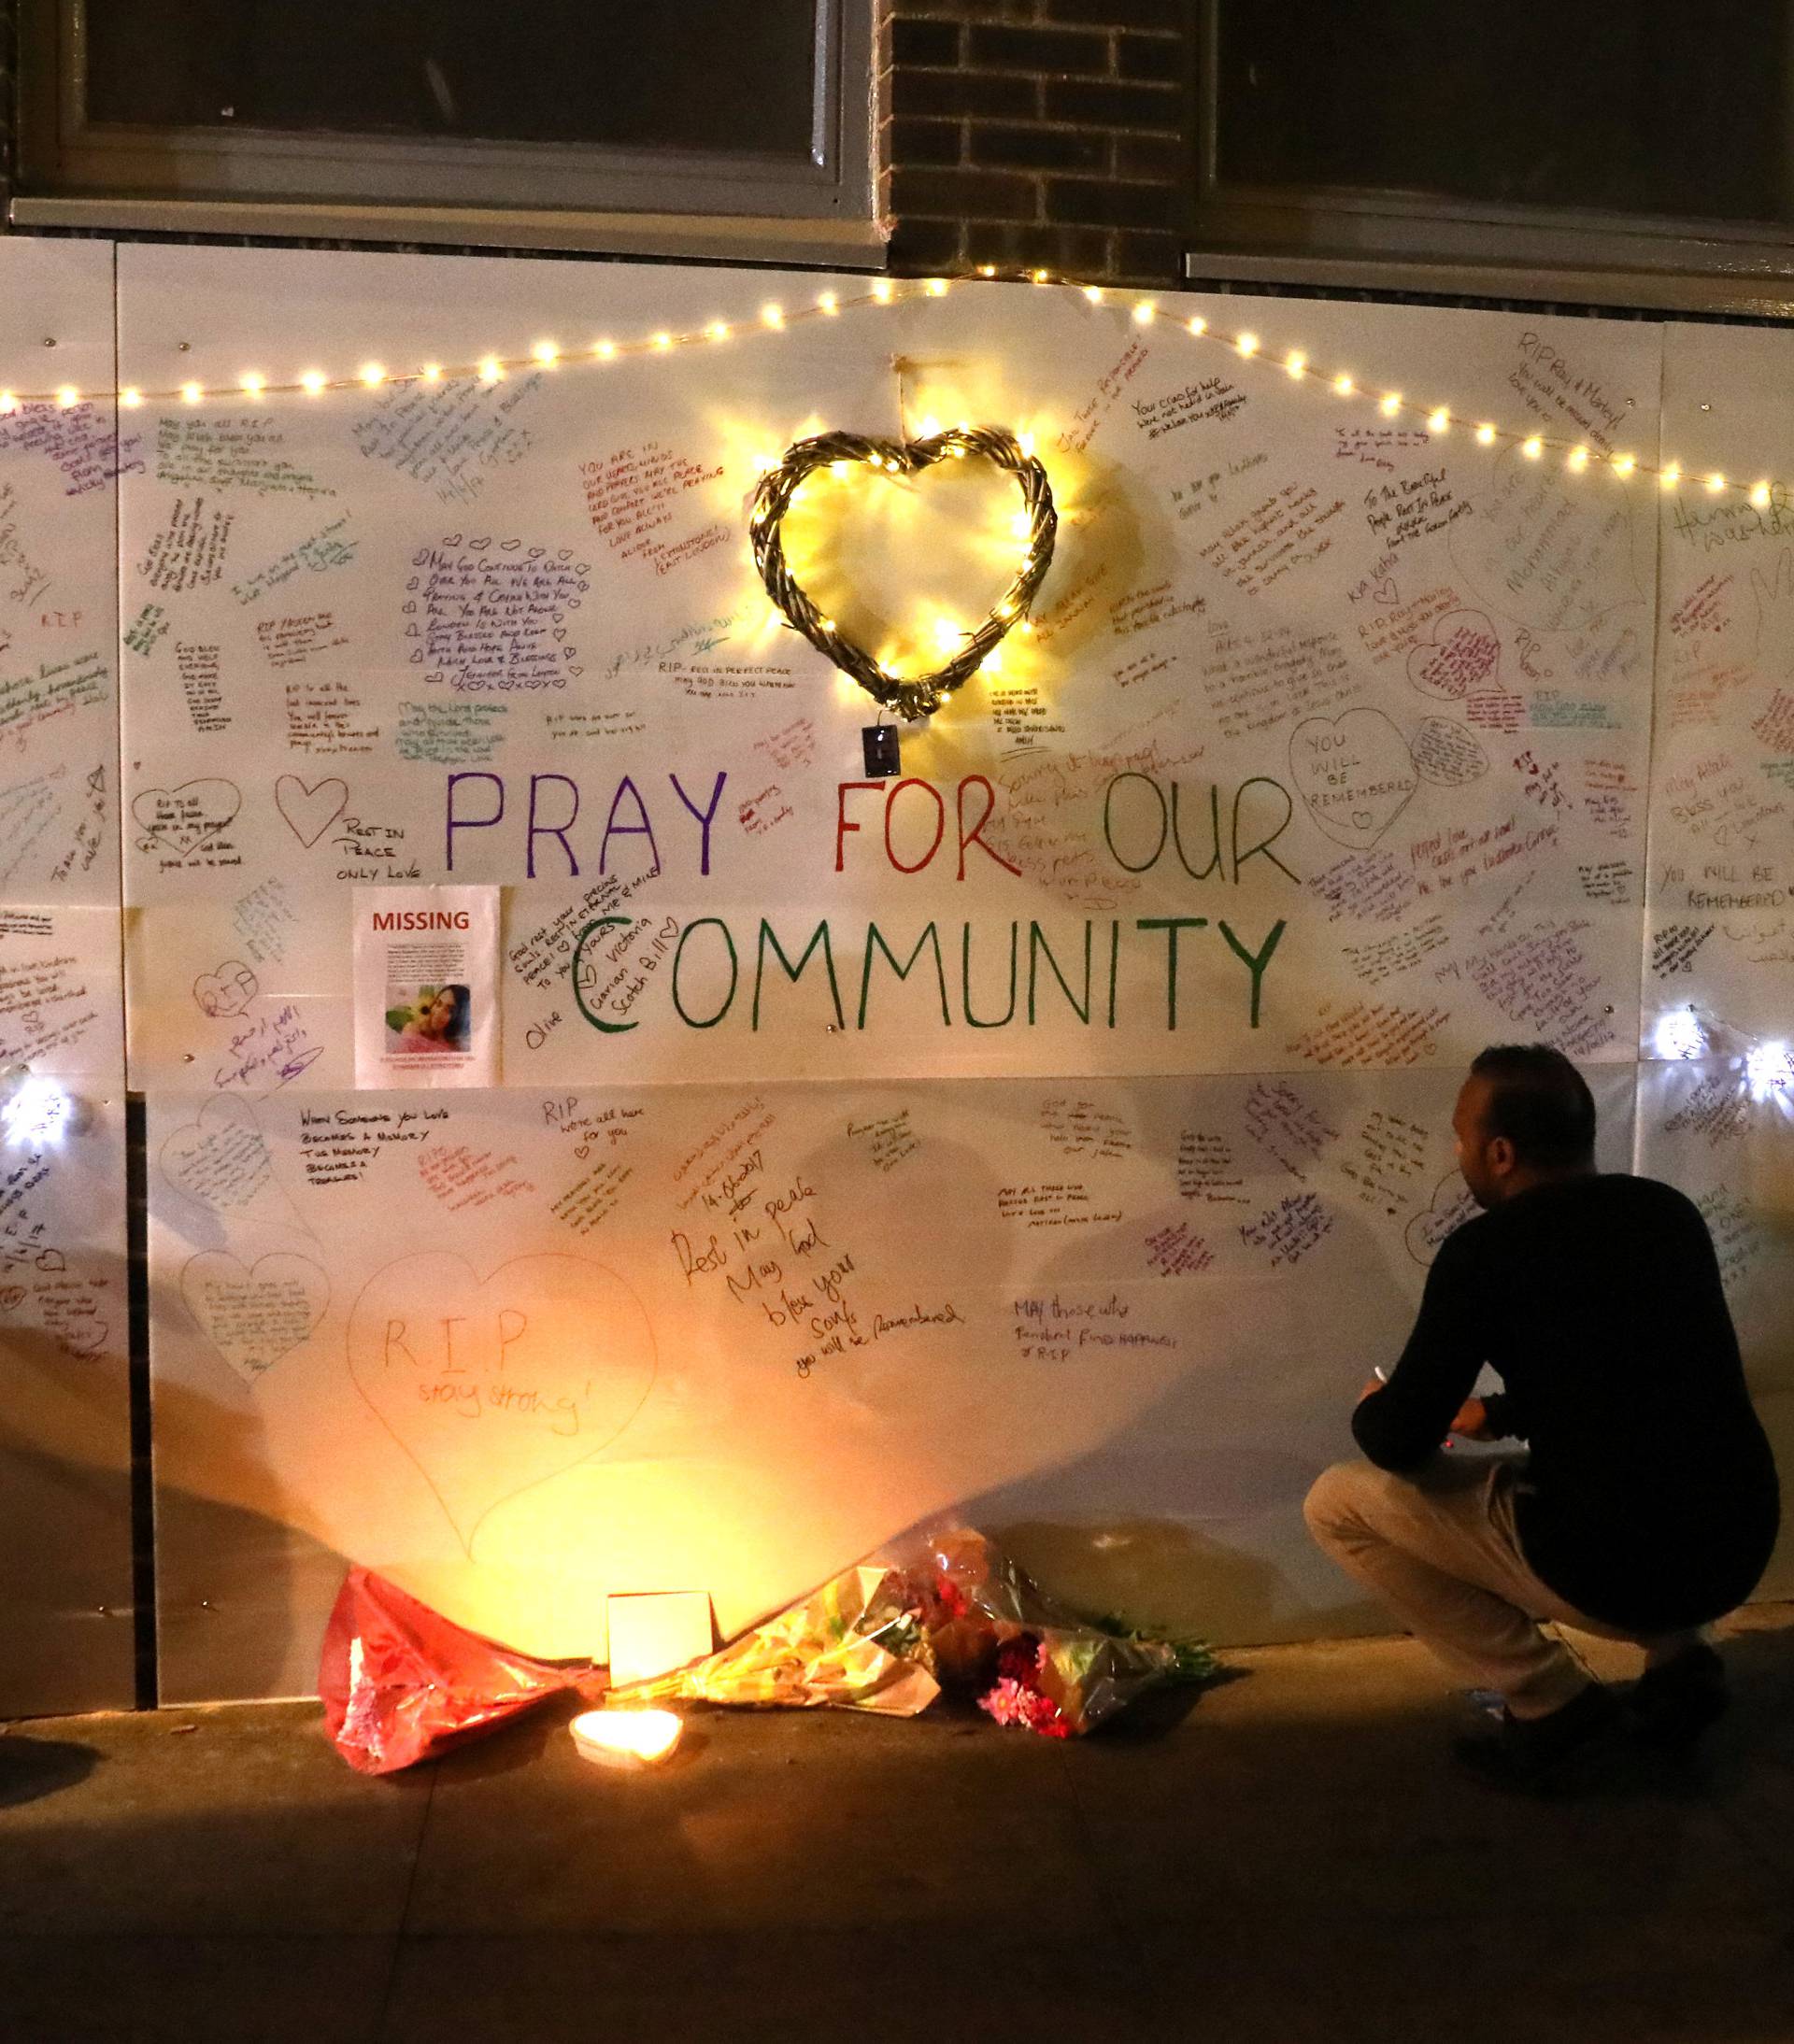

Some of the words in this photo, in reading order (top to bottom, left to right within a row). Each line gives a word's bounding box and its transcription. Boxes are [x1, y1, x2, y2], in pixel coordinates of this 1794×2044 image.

[577, 461, 605, 476] YOU
[1326, 771, 1348, 786] BE
[384, 828, 405, 840] IN
[447, 771, 729, 879] PRAY
[834, 777, 1023, 882] FOR
[1103, 772, 1303, 885] OUR
[332, 837, 397, 858] PEACE
[335, 866, 379, 882] ONLY
[373, 911, 470, 931] MISSING
[571, 916, 1289, 1034] COMMUNITY
[543, 1096, 578, 1126] RIP
[670, 1228, 728, 1287] Rest
[726, 1260, 783, 1304] May
[419, 1383, 482, 1419] stay
